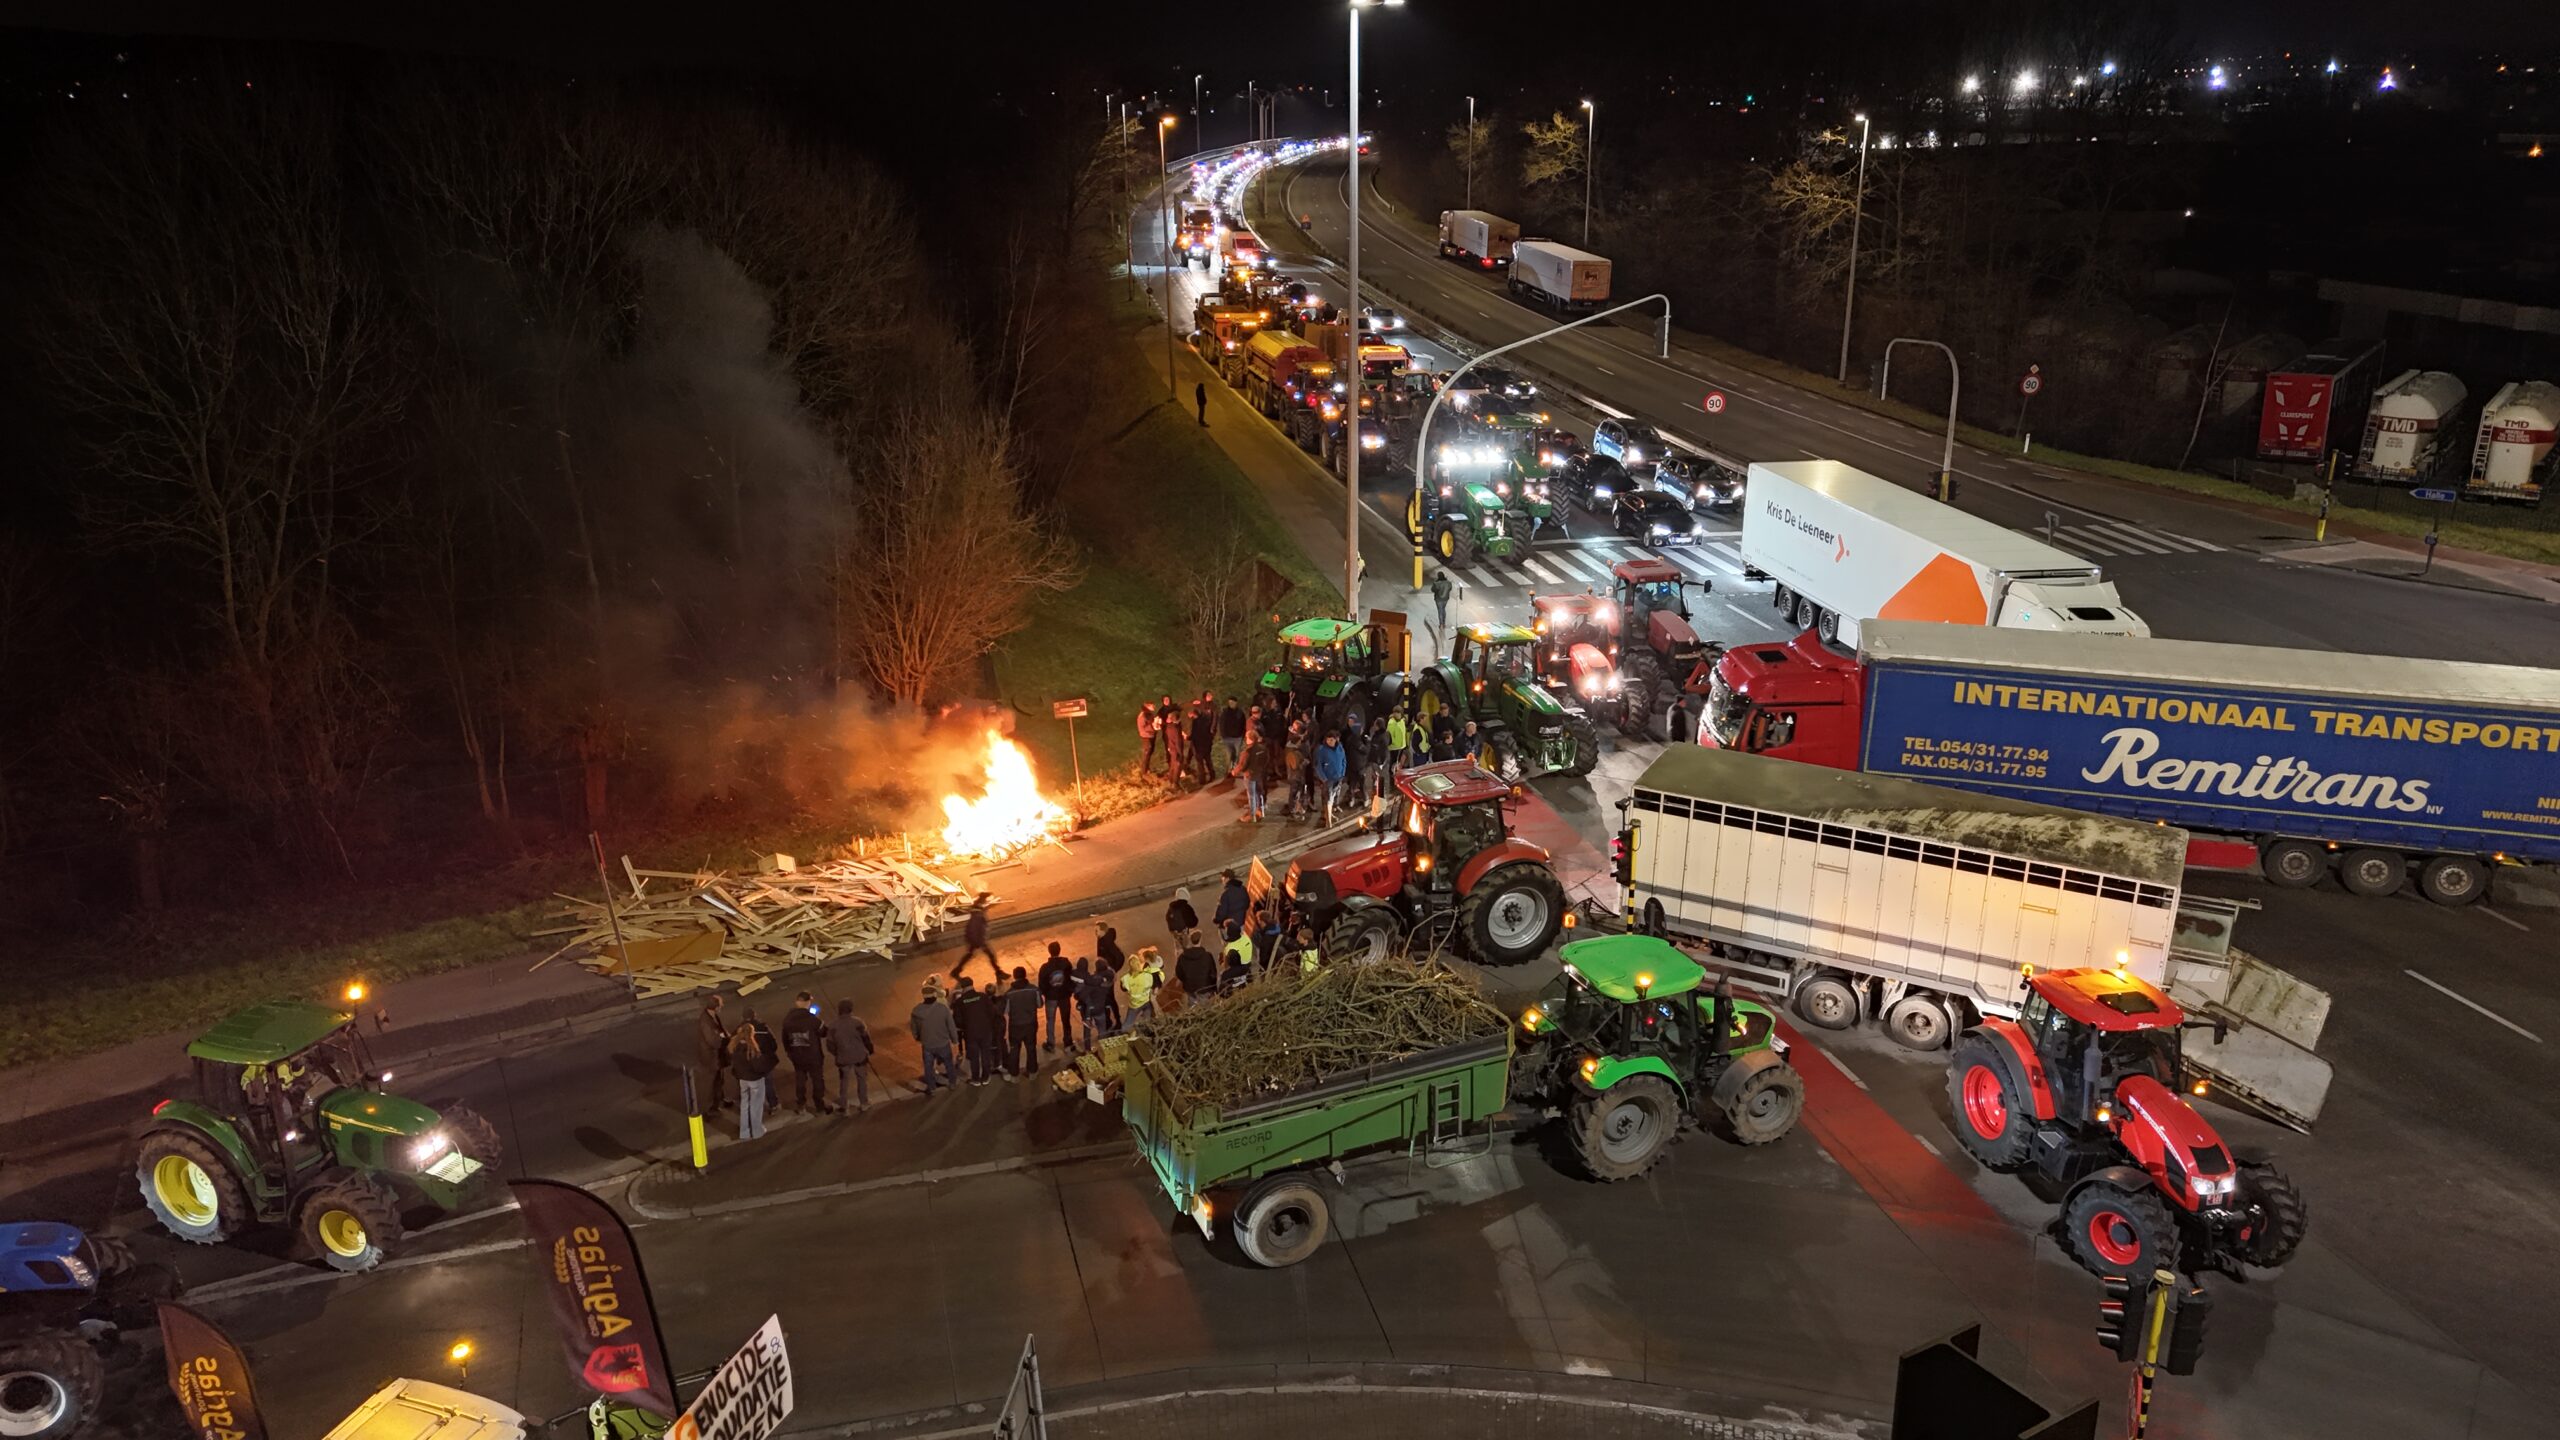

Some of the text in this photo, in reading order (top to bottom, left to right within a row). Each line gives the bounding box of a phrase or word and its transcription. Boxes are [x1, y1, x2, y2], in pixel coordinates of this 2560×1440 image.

[2025, 380, 2038, 390] 90
[1708, 398, 1722, 409] 90
[2382, 417, 2418, 433] TMD
[2503, 419, 2530, 429] TMD
[1766, 500, 1835, 545] Kris De Leeneer
[1954, 682, 2560, 752] INTERNATIONAAL TRANSPORT
[1904, 736, 2050, 763] TEL.054/31.77.94
[1901, 752, 2047, 778] FAX.054/31.77.95
[2082, 727, 2444, 815] Remitrans NV
[1227, 1131, 1272, 1150] RECORD
